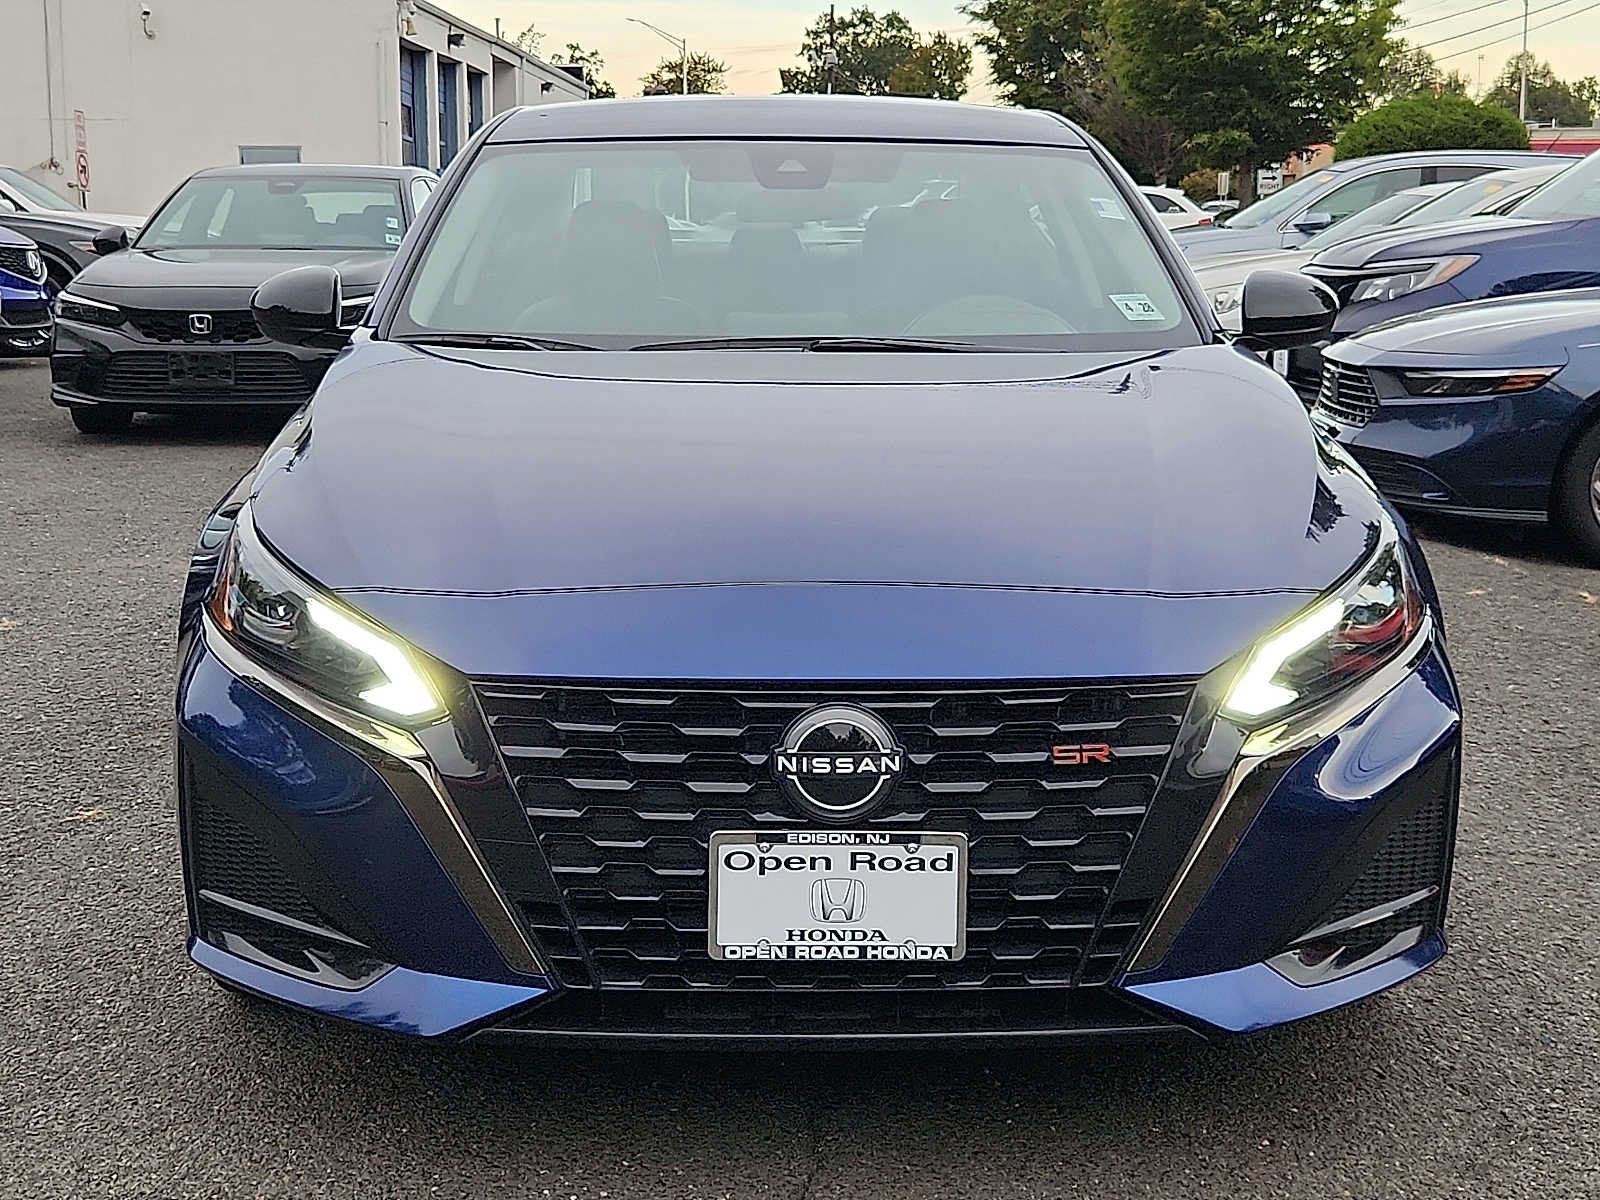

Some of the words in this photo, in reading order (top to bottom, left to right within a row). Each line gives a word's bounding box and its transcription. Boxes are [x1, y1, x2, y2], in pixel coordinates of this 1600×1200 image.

[1053, 744, 1111, 765] SR
[777, 755, 900, 775] NISSAN
[787, 833, 860, 845] EDISON,
[867, 833, 890, 844] NJ
[723, 850, 832, 876] Open
[849, 851, 954, 872] Road
[785, 929, 889, 942] HONDA
[724, 945, 788, 960] OPEN
[794, 945, 860, 960] ROAD
[866, 945, 949, 960] HONDA
